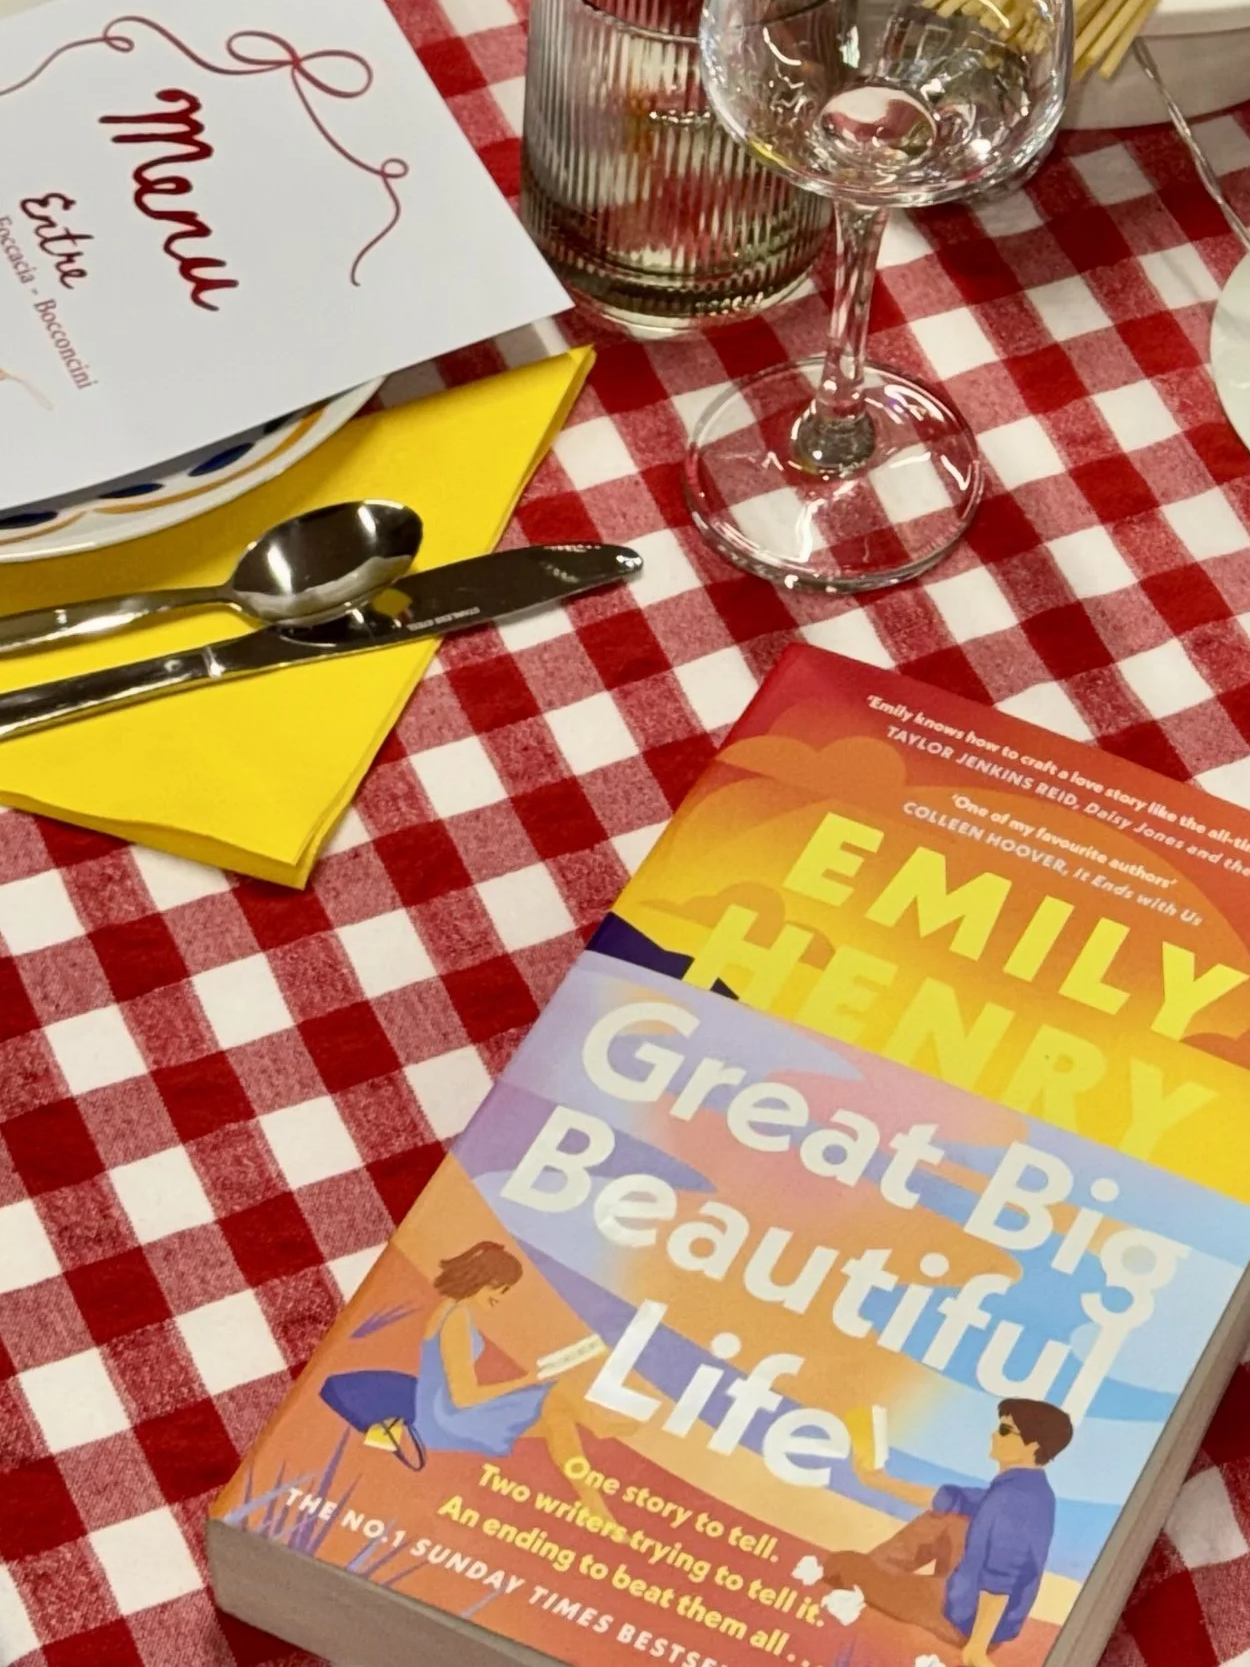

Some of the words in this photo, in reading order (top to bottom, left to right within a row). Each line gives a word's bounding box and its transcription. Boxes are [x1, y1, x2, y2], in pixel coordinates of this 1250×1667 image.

[19, 192, 95, 290] Entre
[97, 87, 239, 312] Menu
[33, 298, 99, 390] Bocconcini
[887, 725, 954, 760] TAYLOR
[955, 752, 1035, 790] JENKINS
[1035, 782, 1080, 810] REID,
[1083, 801, 1133, 830] Daisy
[1133, 822, 1184, 850] Jones
[1186, 844, 1224, 864] and
[914, 712, 965, 740] knows
[965, 731, 1000, 753] how
[1002, 746, 1019, 760] to
[1020, 755, 1058, 777] craft
[1057, 768, 1069, 780] a
[1070, 771, 1104, 793] love
[1104, 784, 1148, 811] story
[1148, 801, 1177, 822] like
[1179, 815, 1206, 833] the
[990, 812, 1010, 826] of
[1009, 818, 1037, 837] my
[1036, 827, 1108, 865] favourite
[782, 811, 1250, 1042] EMILY
[902, 801, 984, 841] COLLEEN
[986, 832, 1069, 877] HOOVER,
[1073, 867, 1090, 882] It
[1091, 874, 1134, 899] Ends
[1136, 894, 1177, 919] with
[1181, 908, 1203, 928] Us
[683, 903, 1220, 1162] HENRY
[582, 1001, 944, 1209] Great
[963, 1141, 1191, 1327] Big
[500, 1105, 1122, 1428] Beautiful
[584, 1299, 851, 1487] Life
[285, 1486, 336, 1522] THE
[340, 1510, 406, 1549] NO.1
[409, 1537, 526, 1596] SUNDAY
[529, 1584, 615, 1636] TIMES
[438, 1494, 479, 1529] An
[482, 1516, 576, 1572] ending
[579, 1554, 608, 1582] to
[611, 1564, 675, 1610] beat
[676, 1595, 747, 1641] them
[749, 1628, 790, 1656] all
[478, 1463, 530, 1503] Two
[534, 1491, 629, 1544] writers
[629, 1528, 711, 1584] trying
[714, 1565, 744, 1591] to
[747, 1578, 798, 1613] tell
[795, 1596, 825, 1628] it.
[564, 1455, 621, 1496] One
[622, 1484, 694, 1529] story
[694, 1511, 725, 1538] to
[727, 1526, 780, 1563] tell.
